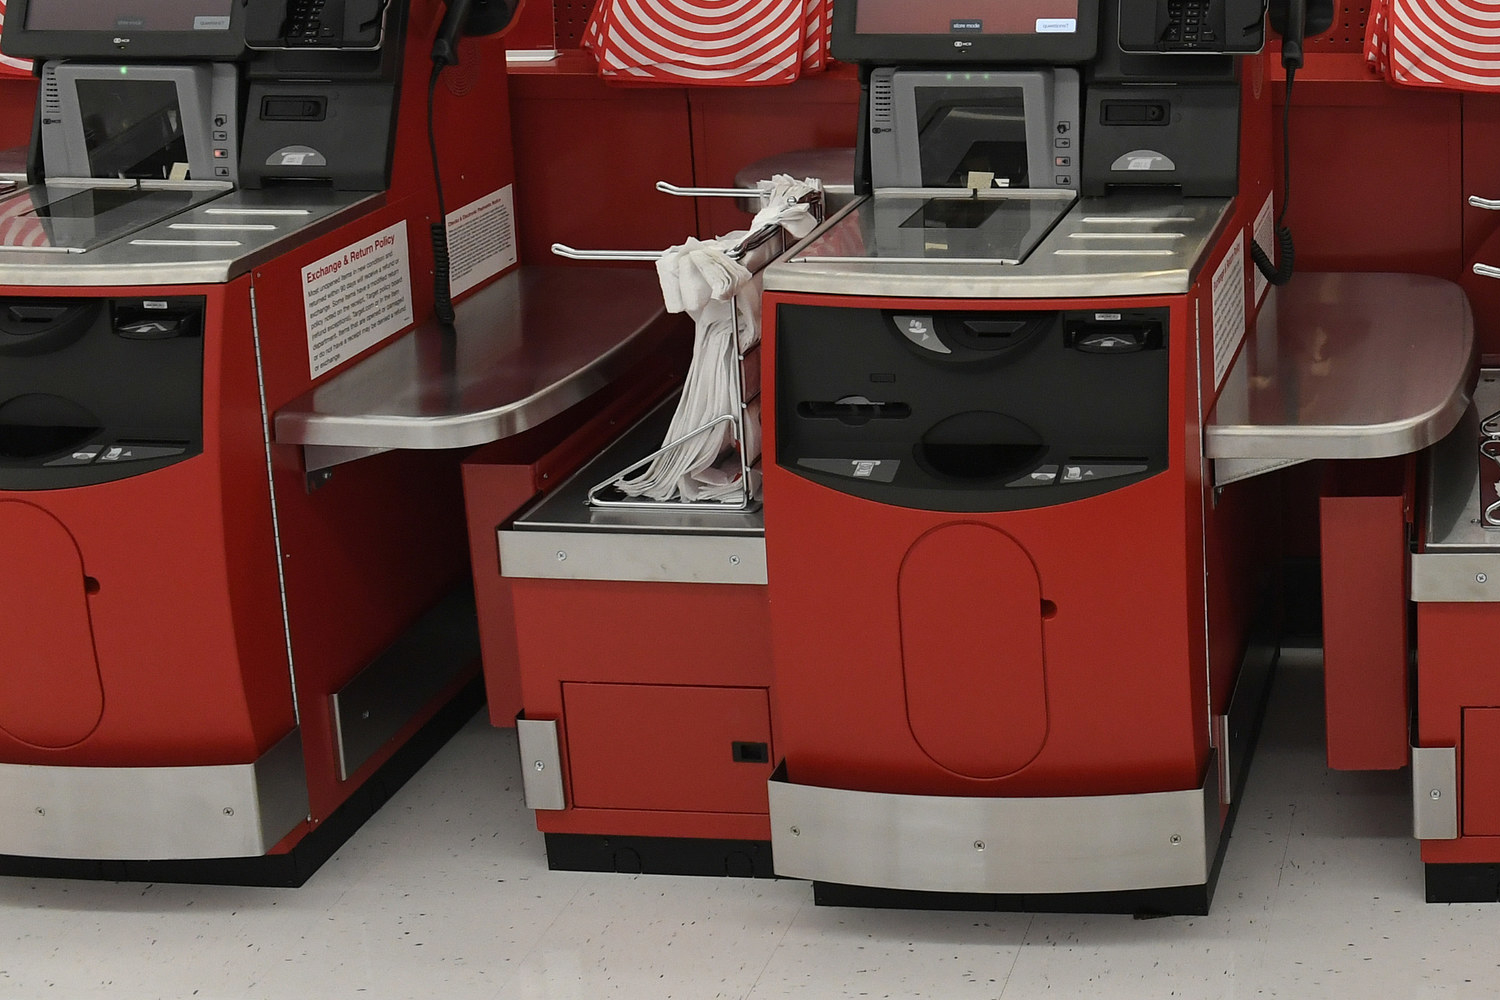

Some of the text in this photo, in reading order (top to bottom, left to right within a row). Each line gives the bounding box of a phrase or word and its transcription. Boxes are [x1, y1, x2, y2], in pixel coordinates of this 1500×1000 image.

[307, 234, 395, 283] Exchange & Return Policy
